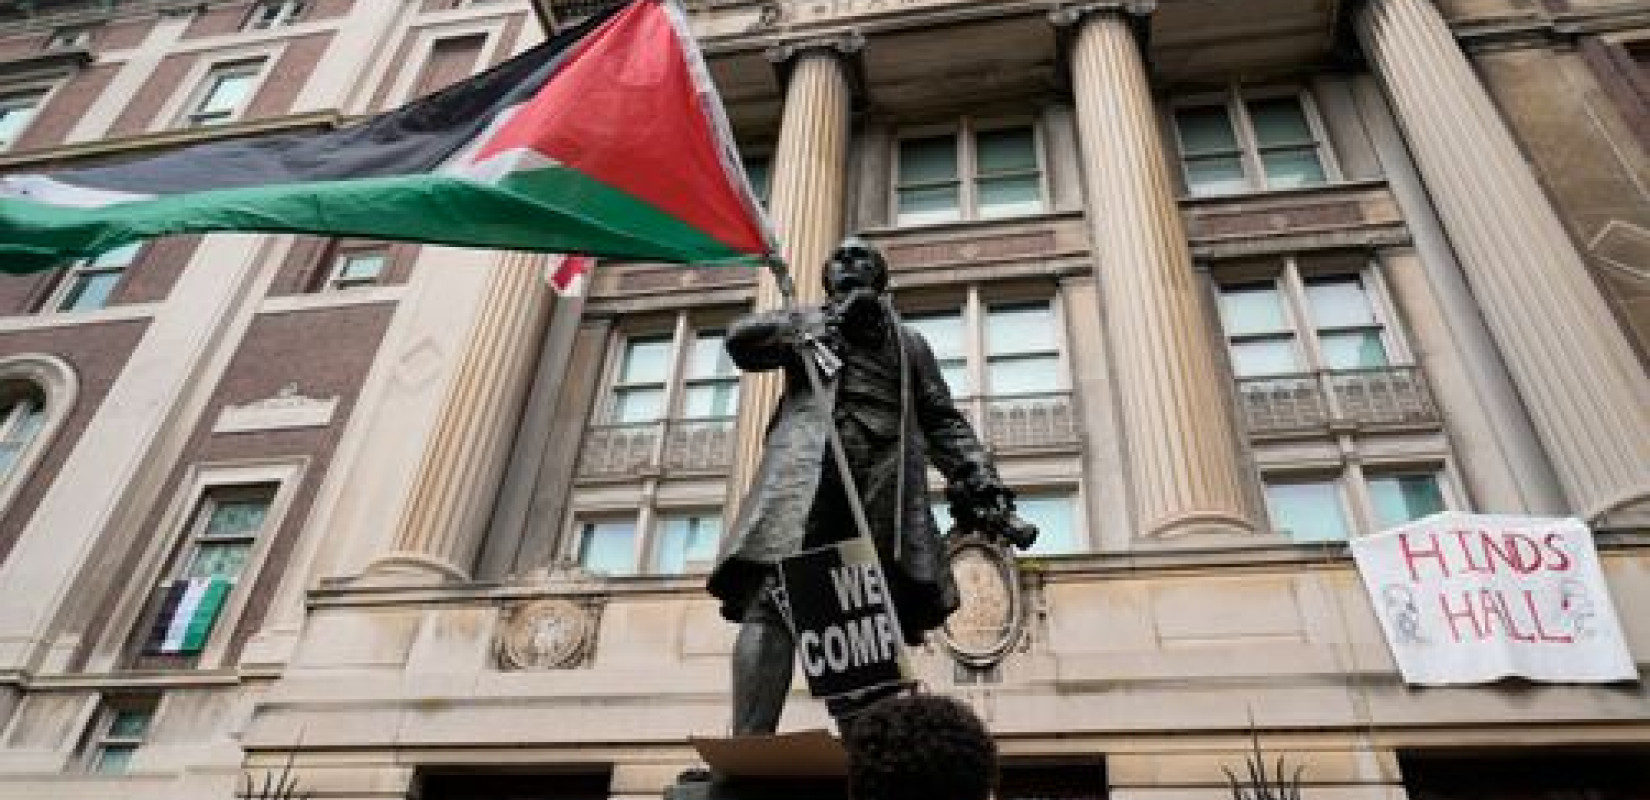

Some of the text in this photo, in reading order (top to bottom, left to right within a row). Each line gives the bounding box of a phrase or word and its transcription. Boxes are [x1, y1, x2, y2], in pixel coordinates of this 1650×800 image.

[1398, 530, 1571, 581] HINDS
[830, 564, 884, 611] WE
[1439, 589, 1574, 643] HALL
